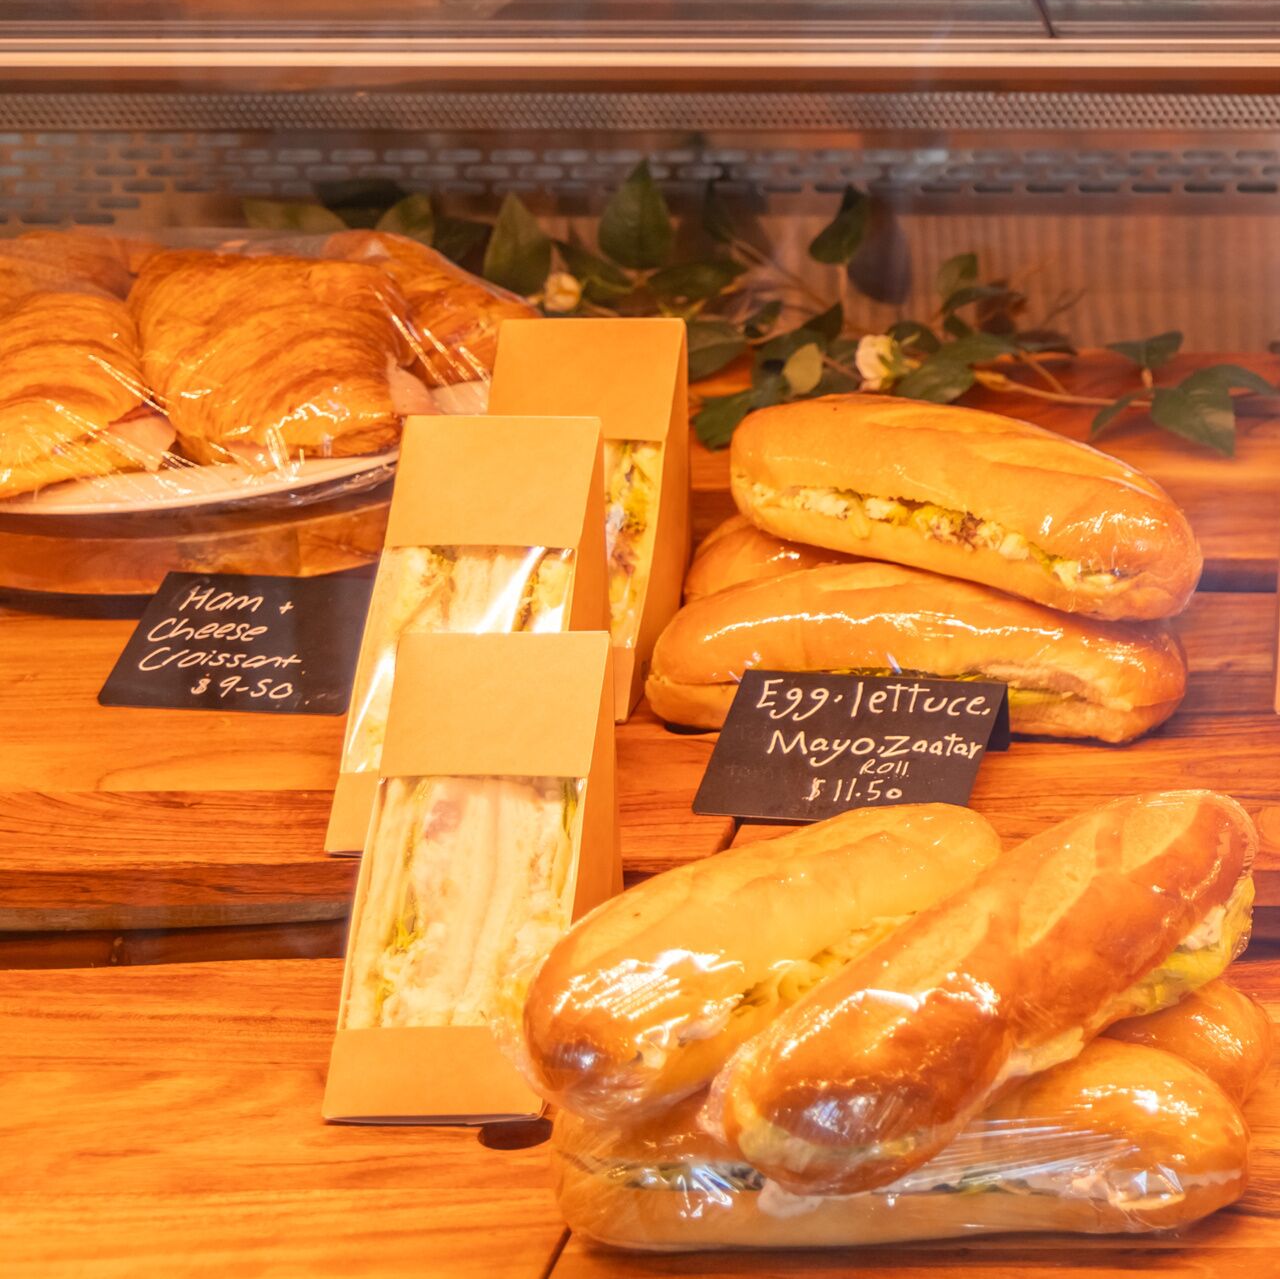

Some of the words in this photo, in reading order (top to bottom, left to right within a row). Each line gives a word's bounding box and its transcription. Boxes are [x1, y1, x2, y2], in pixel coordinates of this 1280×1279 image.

[179, 585, 264, 612] Ham
[147, 618, 268, 642] Cheese
[138, 647, 302, 671] Croissant
